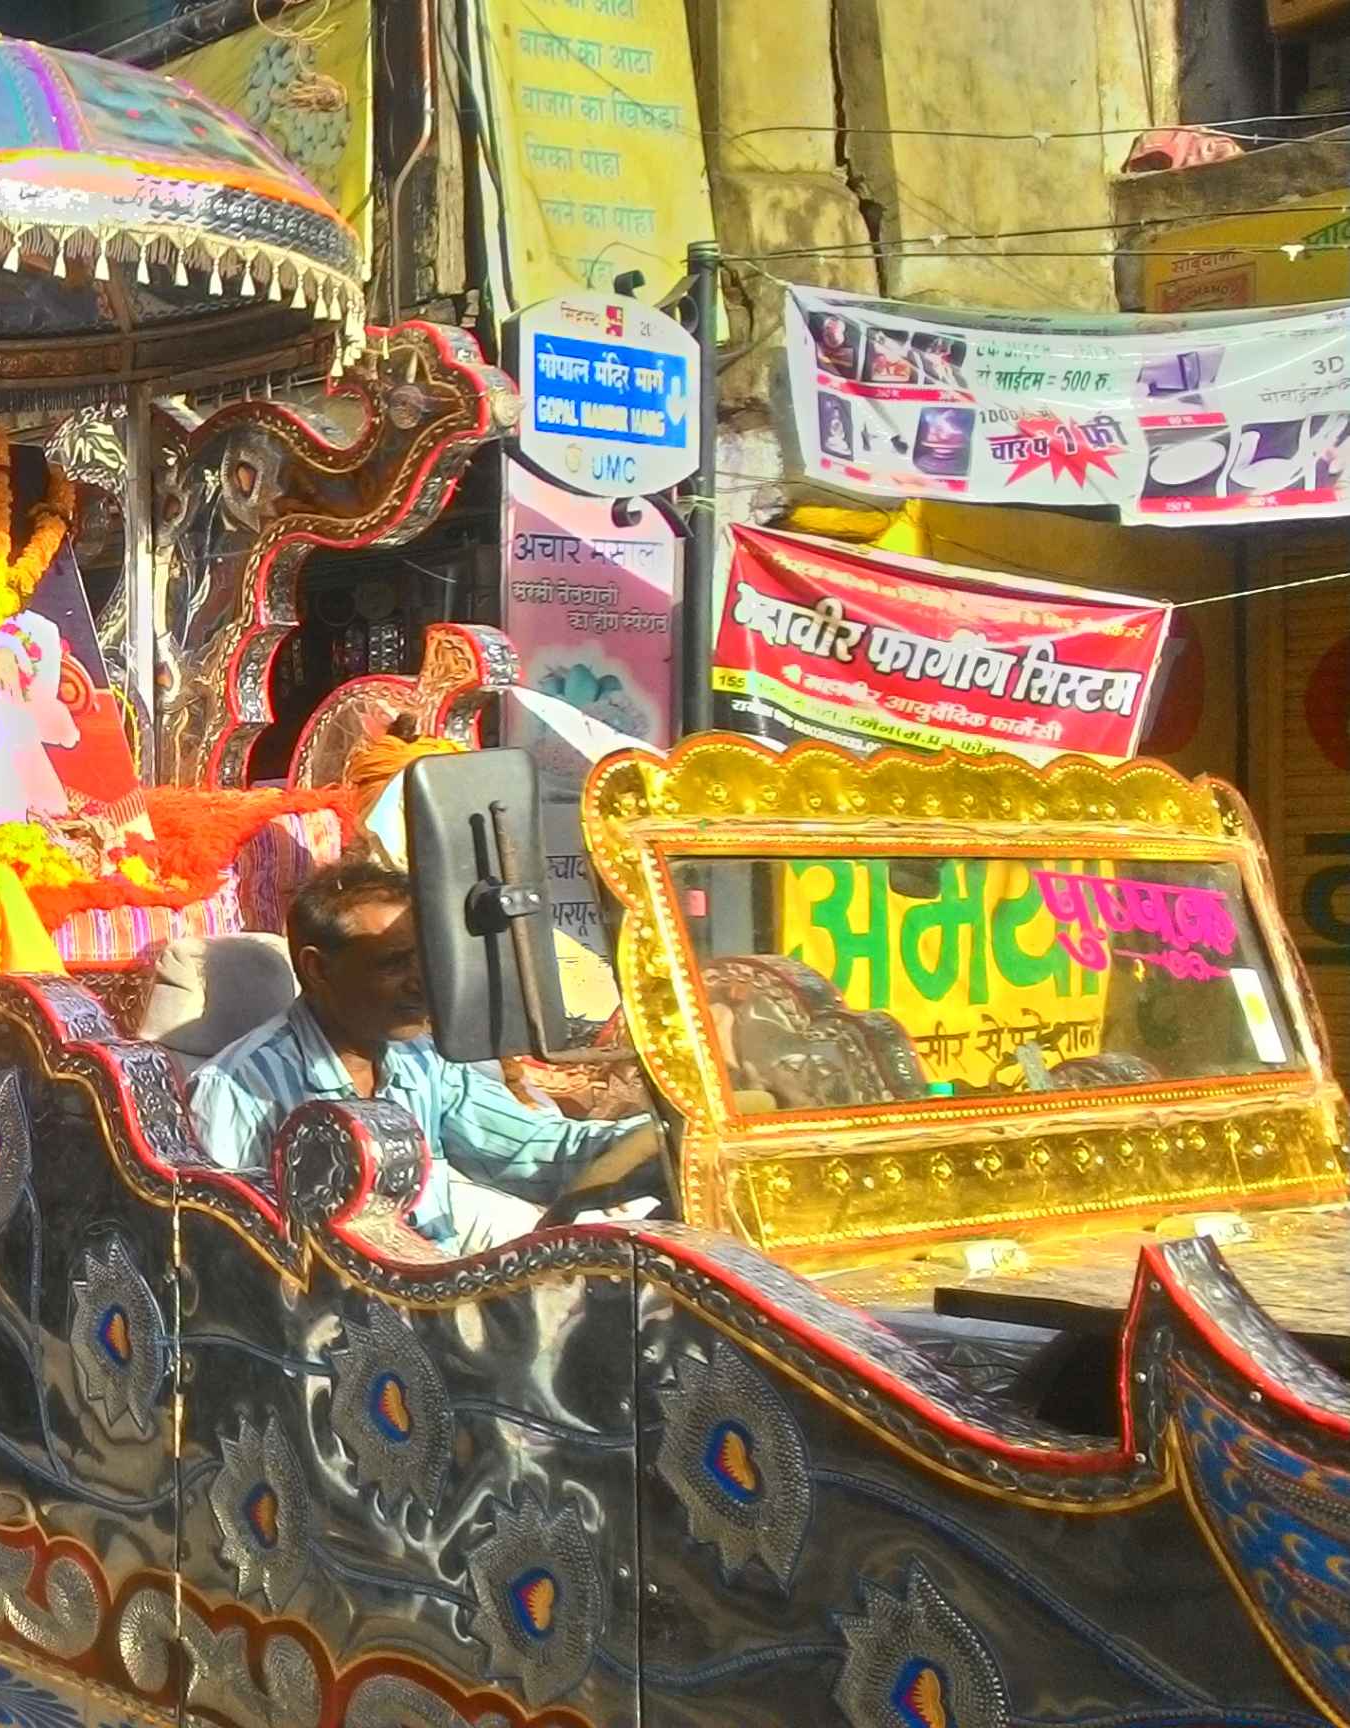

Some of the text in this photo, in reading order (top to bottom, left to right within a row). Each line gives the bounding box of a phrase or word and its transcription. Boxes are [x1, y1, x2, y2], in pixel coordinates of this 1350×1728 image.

[536, 342, 666, 395] गोपाल मंदिर मार्ग
[1060, 370, 1092, 393] 500
[1312, 355, 1345, 376] 3D
[537, 395, 579, 428] GOPAL
[592, 454, 637, 484] UMC
[514, 533, 582, 565] अचार
[1011, 637, 1143, 717] सिस्टम
